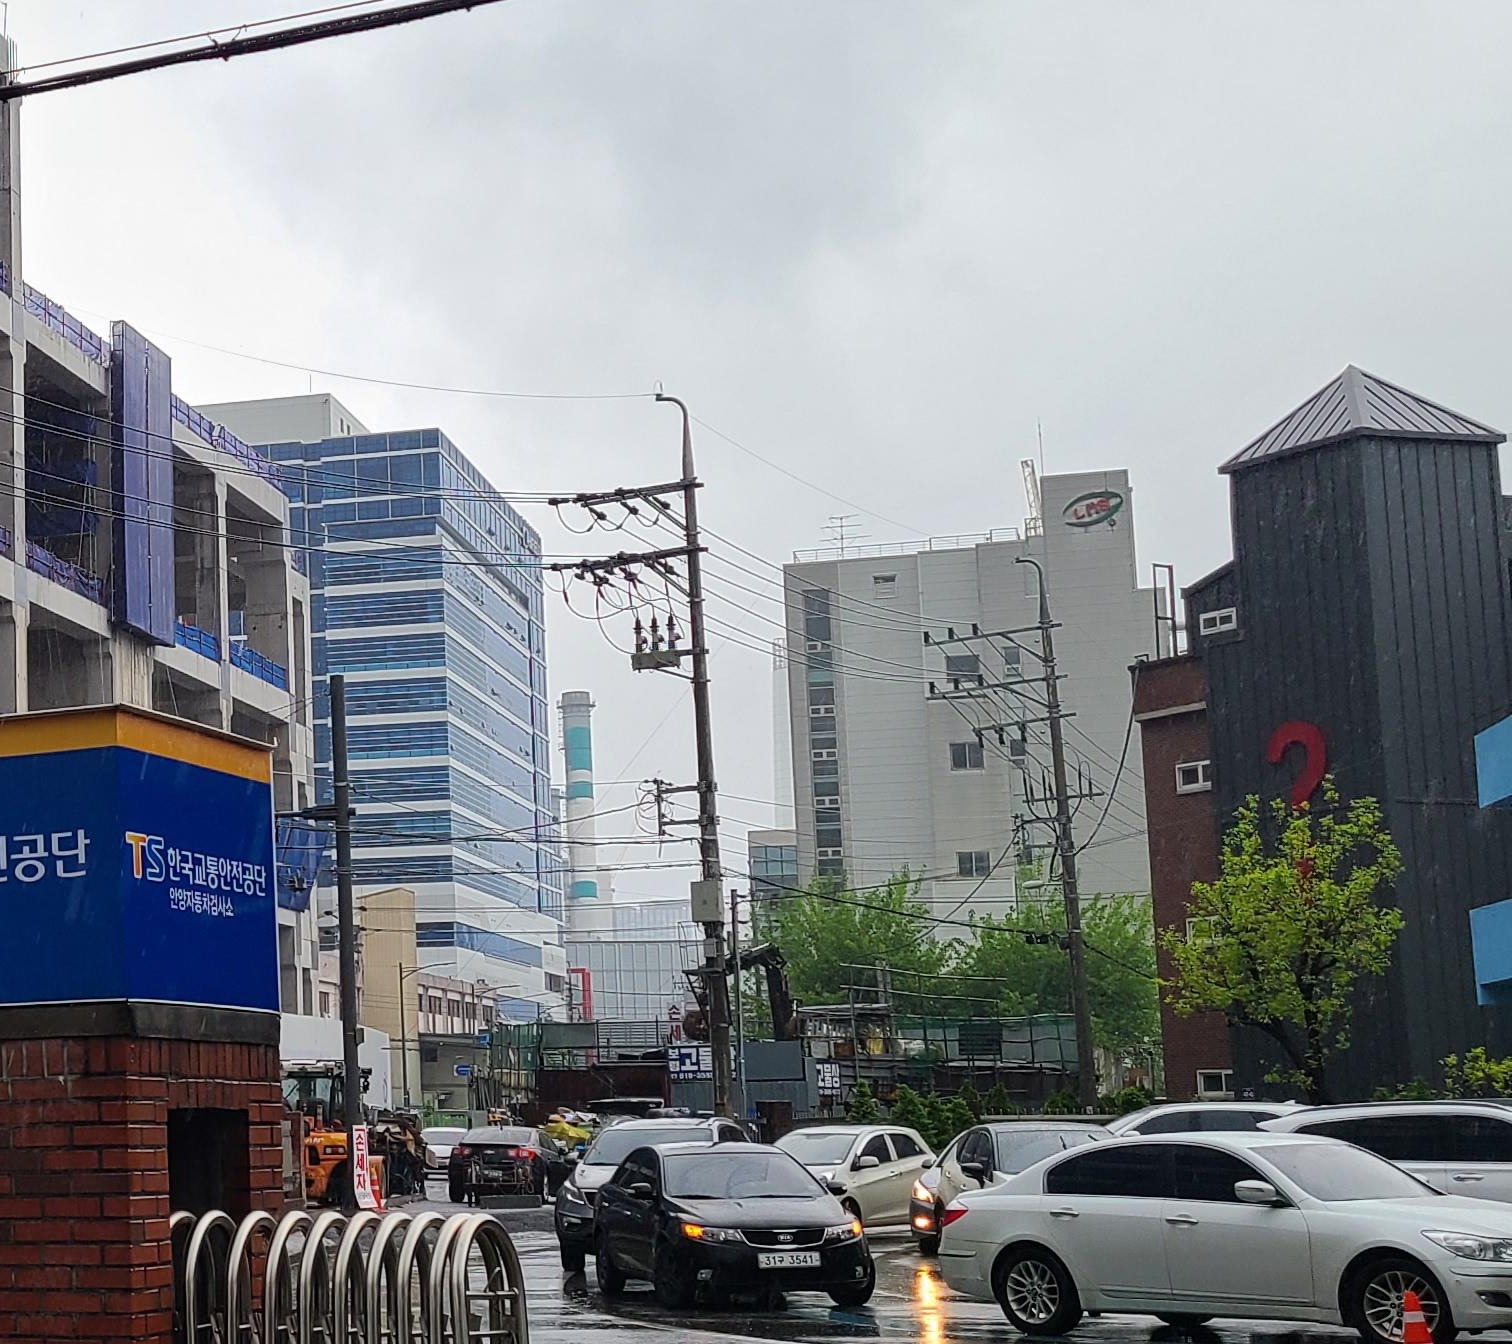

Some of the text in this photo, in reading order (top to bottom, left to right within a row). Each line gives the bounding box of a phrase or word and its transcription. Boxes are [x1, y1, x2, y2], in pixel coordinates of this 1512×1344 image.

[125, 831, 267, 897] TS 한국교통안전공단
[169, 887, 234, 917] 안양자동차검사소
[789, 1254, 814, 1265] 3541
